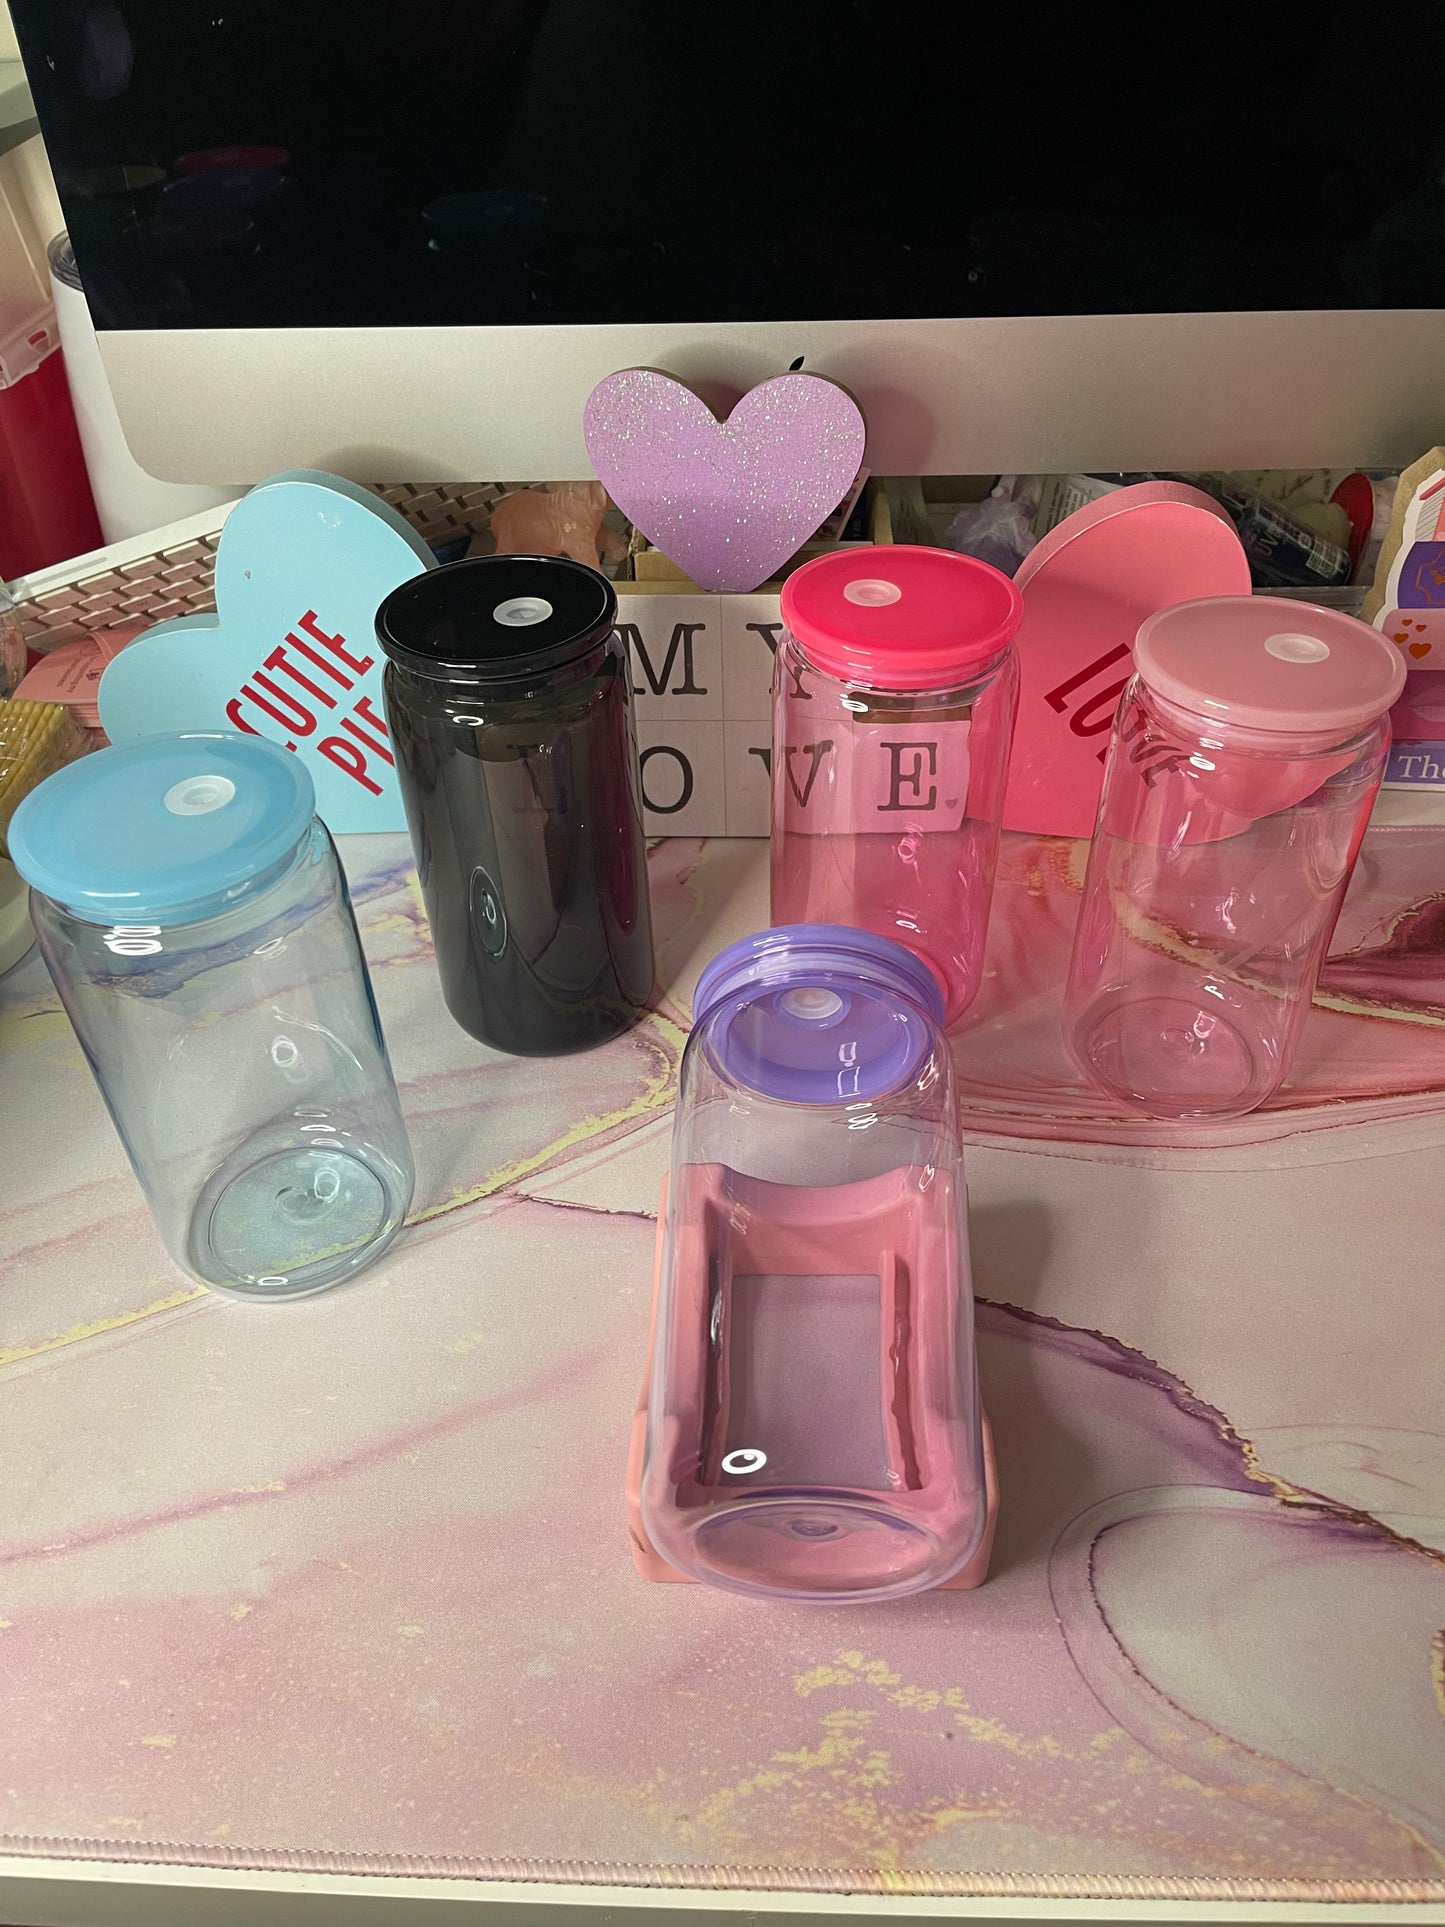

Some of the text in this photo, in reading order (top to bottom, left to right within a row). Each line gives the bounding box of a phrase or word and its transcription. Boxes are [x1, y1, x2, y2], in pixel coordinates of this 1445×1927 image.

[226, 609, 375, 753] CUTIE
[640, 740, 938, 812] OVE
[1398, 754, 1445, 779] Th
